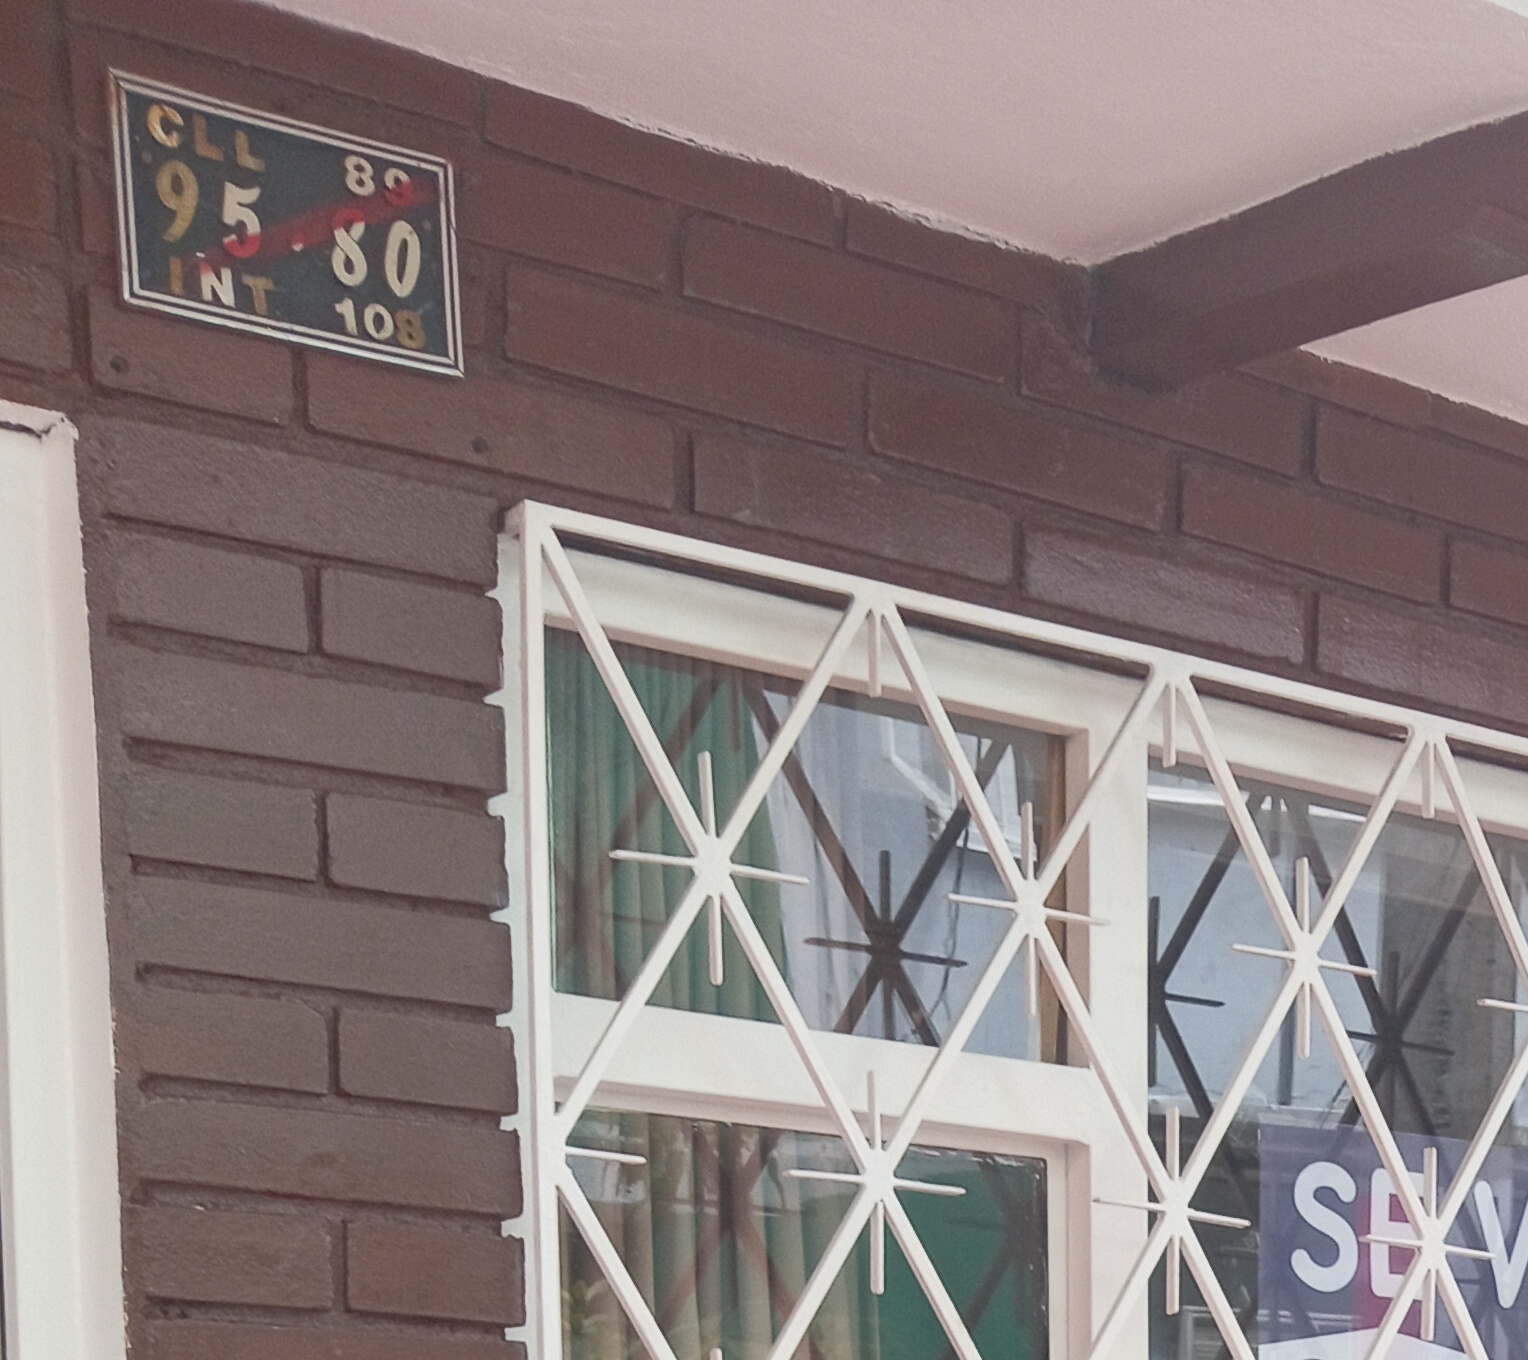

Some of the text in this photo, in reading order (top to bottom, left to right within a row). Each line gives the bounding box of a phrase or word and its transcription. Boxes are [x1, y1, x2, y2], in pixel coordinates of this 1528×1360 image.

[146, 104, 266, 172] CLL
[155, 160, 262, 258] 95
[168, 256, 426, 349] INT 108
[1290, 1160, 1431, 1301] SE
